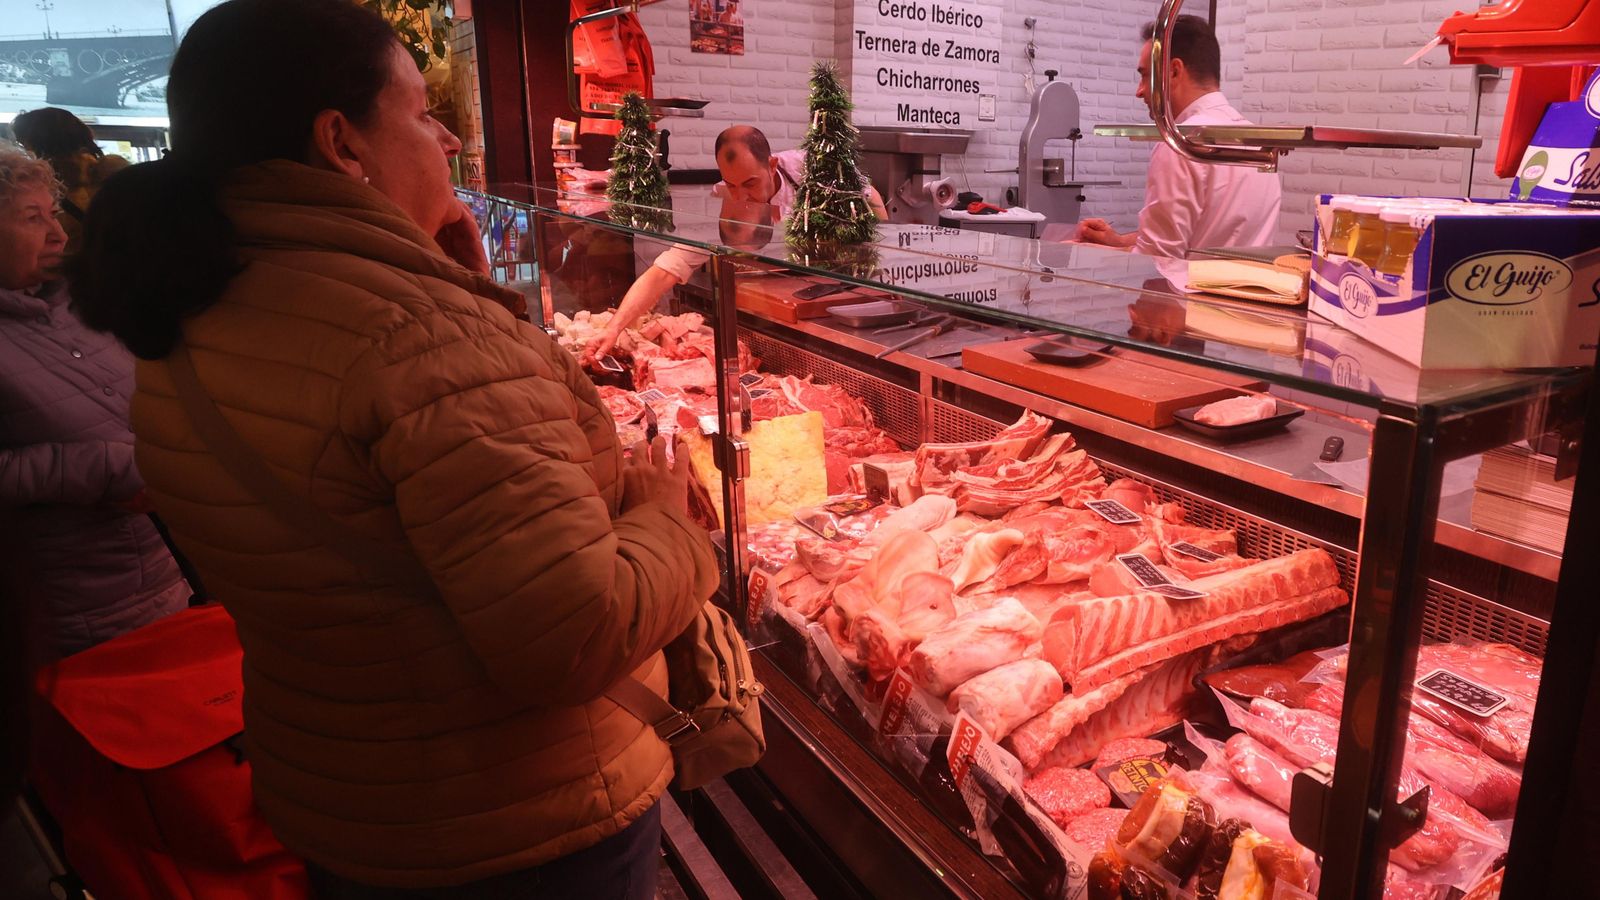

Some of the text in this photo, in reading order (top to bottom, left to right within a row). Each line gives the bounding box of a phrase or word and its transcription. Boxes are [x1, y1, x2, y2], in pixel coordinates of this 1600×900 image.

[878, 0, 983, 28] Cerdo Ibérico
[855, 30, 1000, 63] Ternera de Zamora
[877, 67, 980, 94] Chicharrones
[897, 103, 960, 125] Manteca
[1465, 264, 1492, 291] El
[1493, 262, 1554, 297] Guijo
[883, 680, 906, 735] HELEJO
